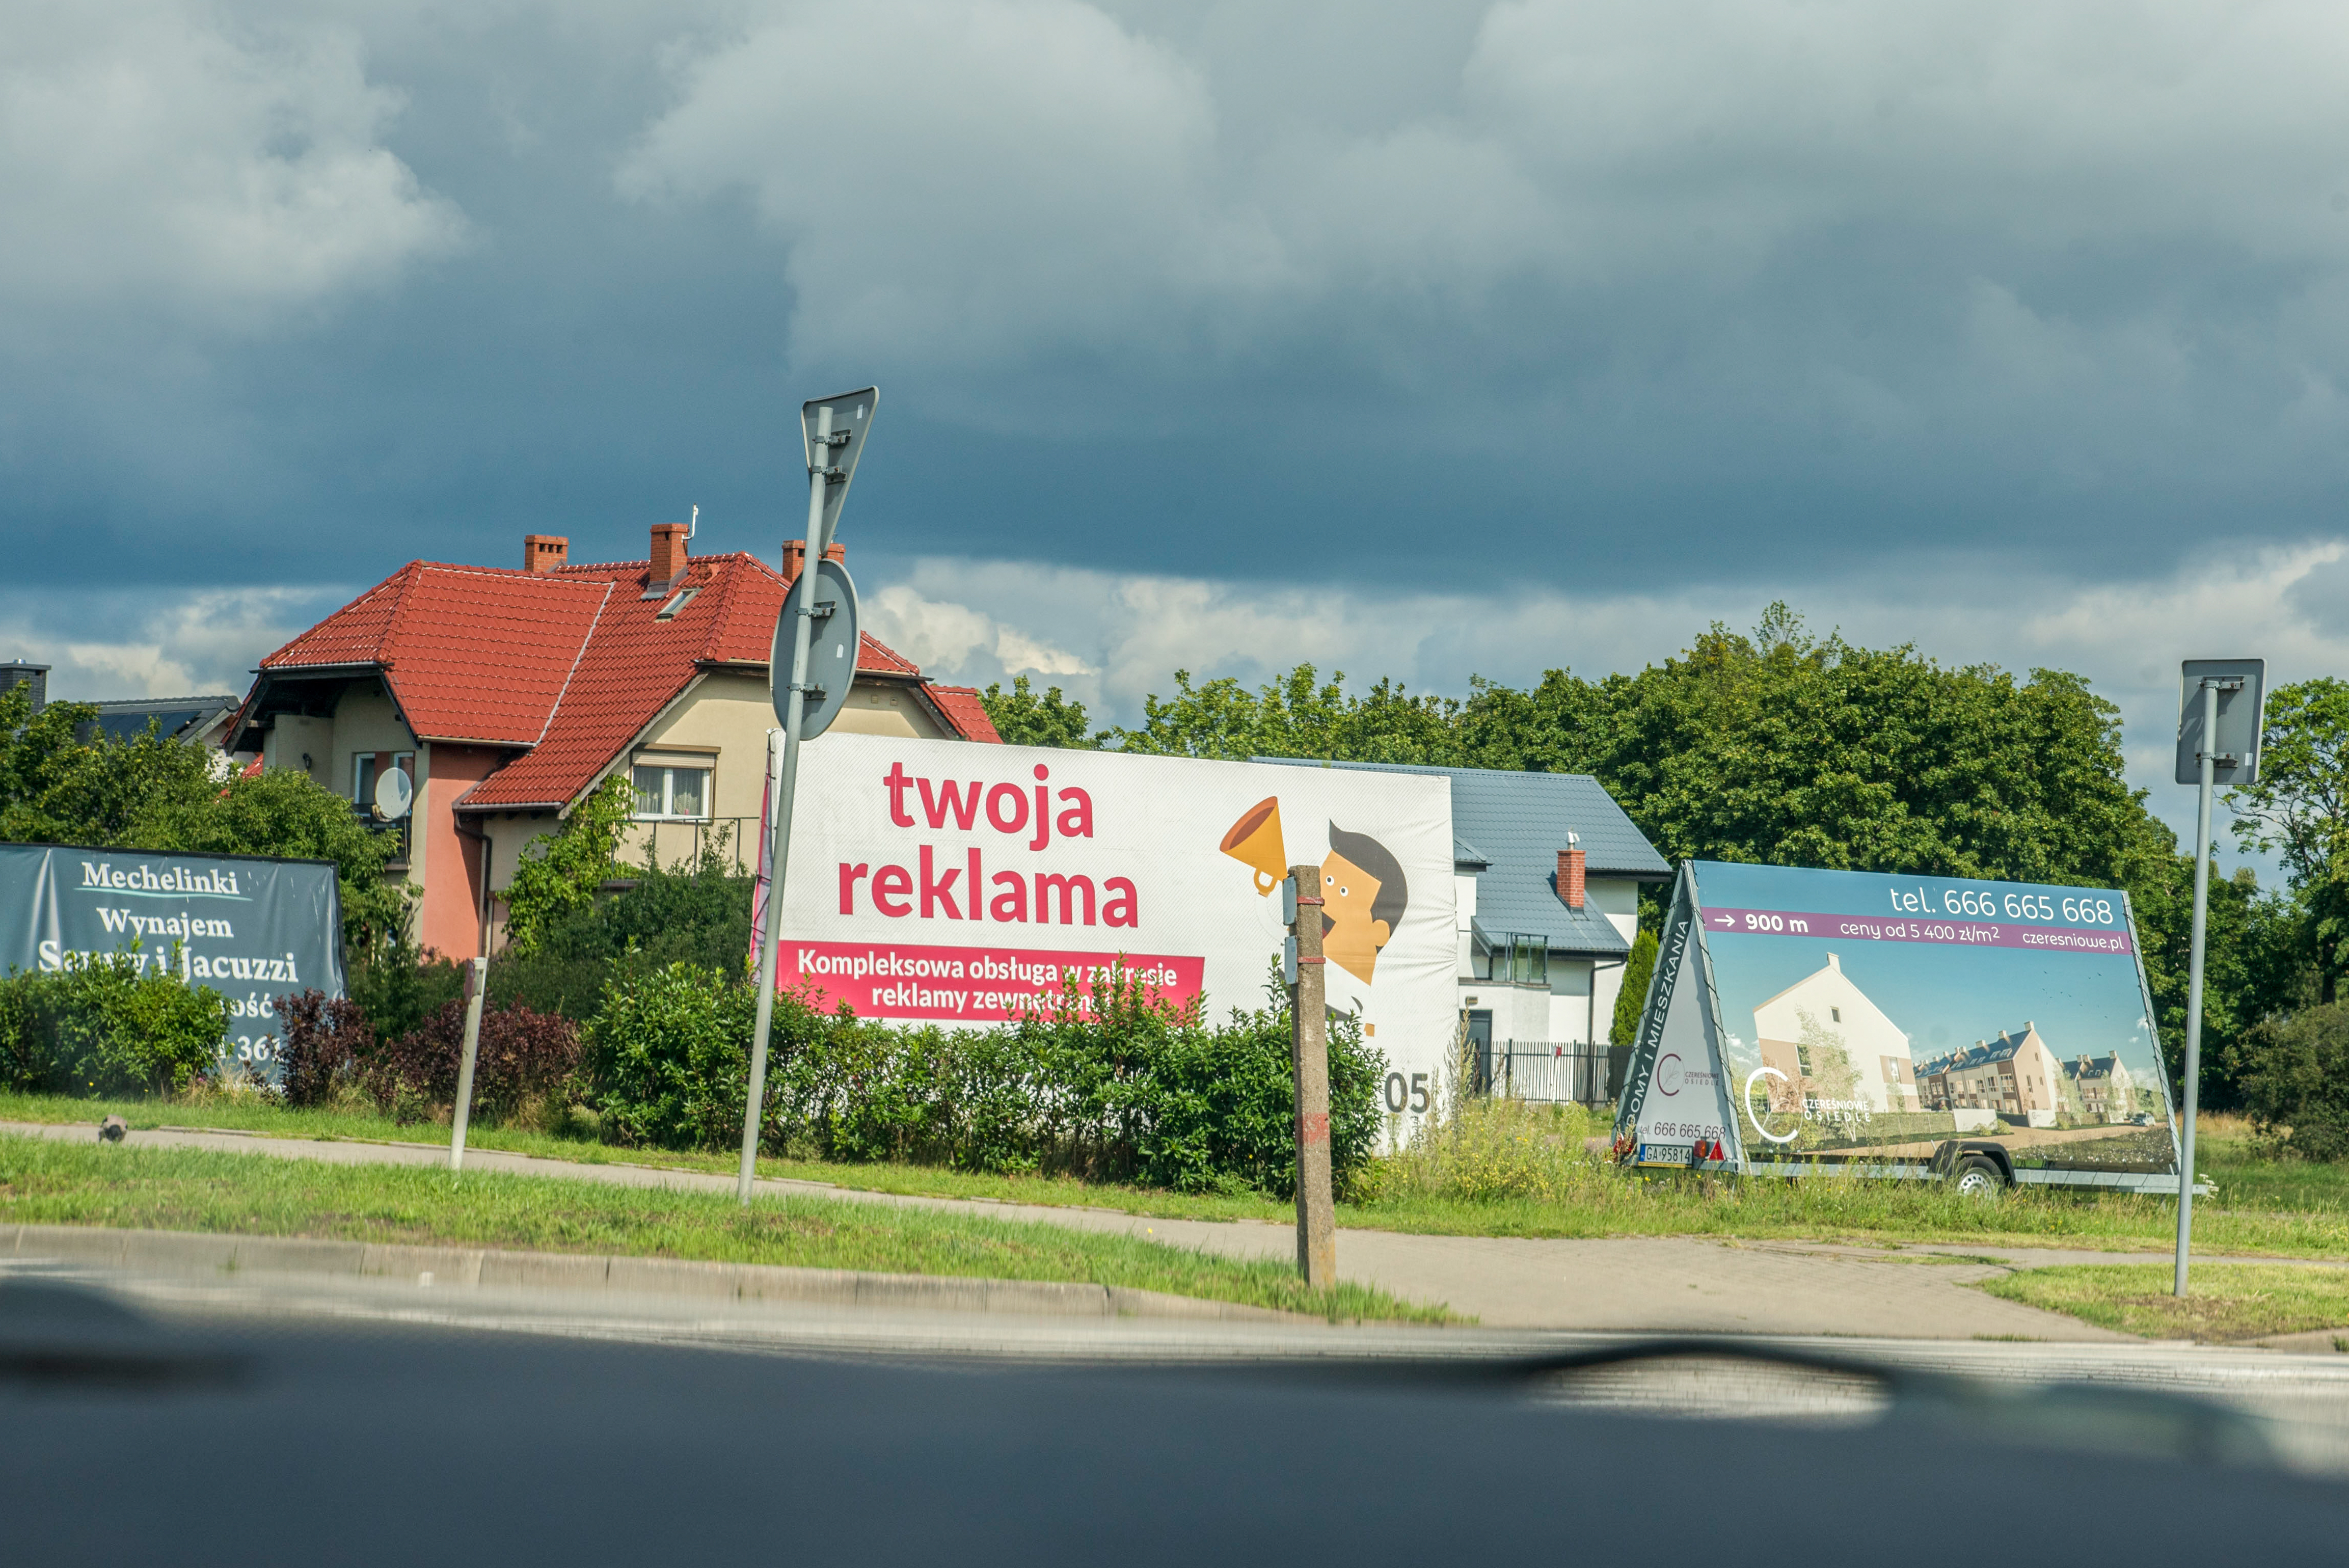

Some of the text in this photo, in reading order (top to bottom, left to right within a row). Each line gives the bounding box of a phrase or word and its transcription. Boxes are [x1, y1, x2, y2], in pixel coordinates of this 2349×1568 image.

[883, 762, 1093, 852] twoja
[82, 862, 239, 895] Mechelinki
[839, 845, 1138, 928] reklama
[1745, 913, 1808, 932] 900 m
[1891, 887, 2113, 924] tel. 666 665 668
[96, 907, 234, 943] Wynajem
[1841, 923, 1881, 939] ceny
[1885, 923, 1906, 937] od
[1910, 924, 1920, 938] 5
[1924, 925, 1954, 939] 400
[2022, 933, 2124, 952] czeresniowe.pl
[156, 946, 167, 976] i
[180, 946, 299, 984] Jacuzzi
[798, 949, 964, 980] Kompleksowa
[969, 955, 1058, 986] obsługa
[1062, 965, 1083, 983] w
[872, 981, 1111, 1015] reklamy zewnętrn
[1627, 1064, 1649, 1125] DOMY
[1648, 921, 1688, 1048] MIESZKANIA
[1385, 1072, 1430, 1114] 05
[1802, 1098, 1869, 1111] CZEREŚNIOWE
[1640, 1122, 1726, 1140] tel. 666 665 668
[1804, 1111, 1871, 1122] OSIEDLE
[1646, 1146, 1690, 1163] GA 95814
